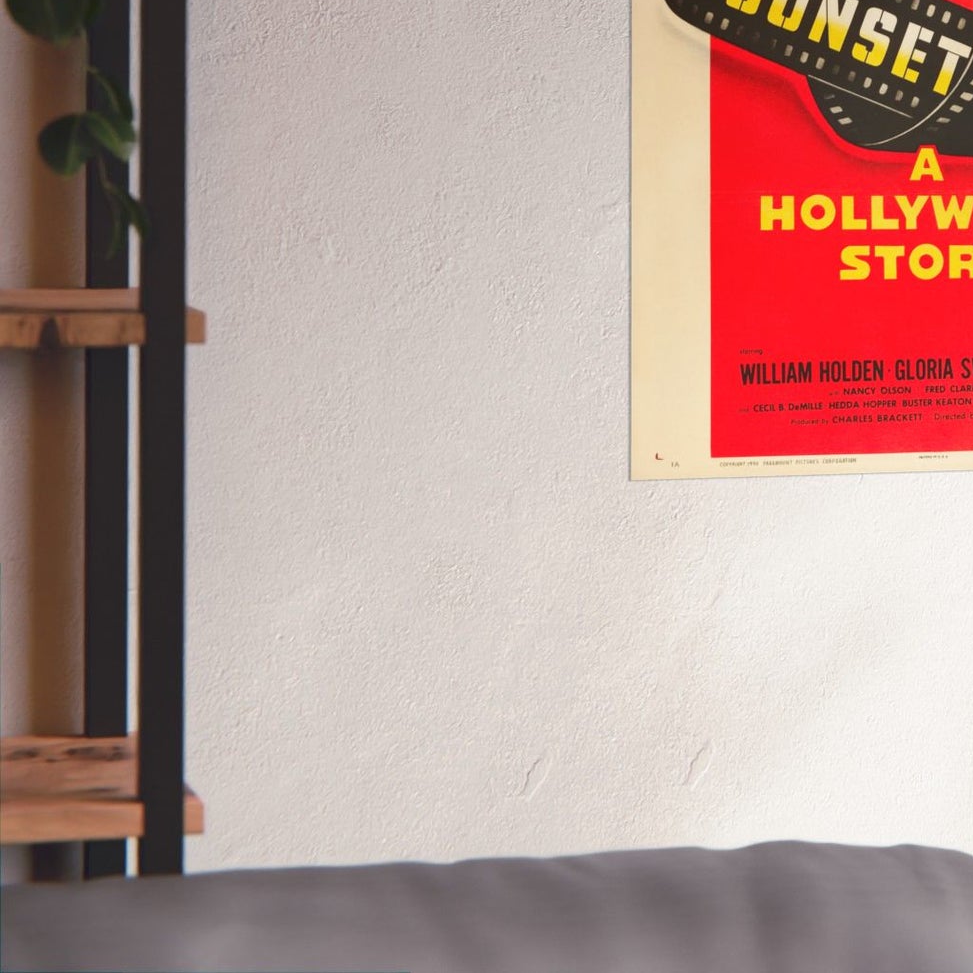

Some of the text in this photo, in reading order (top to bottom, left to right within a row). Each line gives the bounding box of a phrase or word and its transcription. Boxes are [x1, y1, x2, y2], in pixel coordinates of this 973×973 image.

[909, 146, 944, 181] A
[740, 361, 812, 386] WILLIAM
[819, 359, 884, 383] HOLDEN
[895, 358, 954, 381] GLORIA
[843, 386, 876, 395] NANCY
[880, 386, 911, 394] OLSON
[925, 385, 946, 393] FRED
[753, 403, 775, 412] CECIL
[788, 402, 823, 411] DeMILLE
[828, 401, 860, 409] HEDDA
[863, 399, 897, 408] HOPPER
[902, 398, 932, 407] BUSTER
[936, 397, 972, 406] KEATON
[832, 414, 873, 424] CHARLES
[877, 413, 922, 423] BRACKETT
[934, 412, 966, 420] Directed
